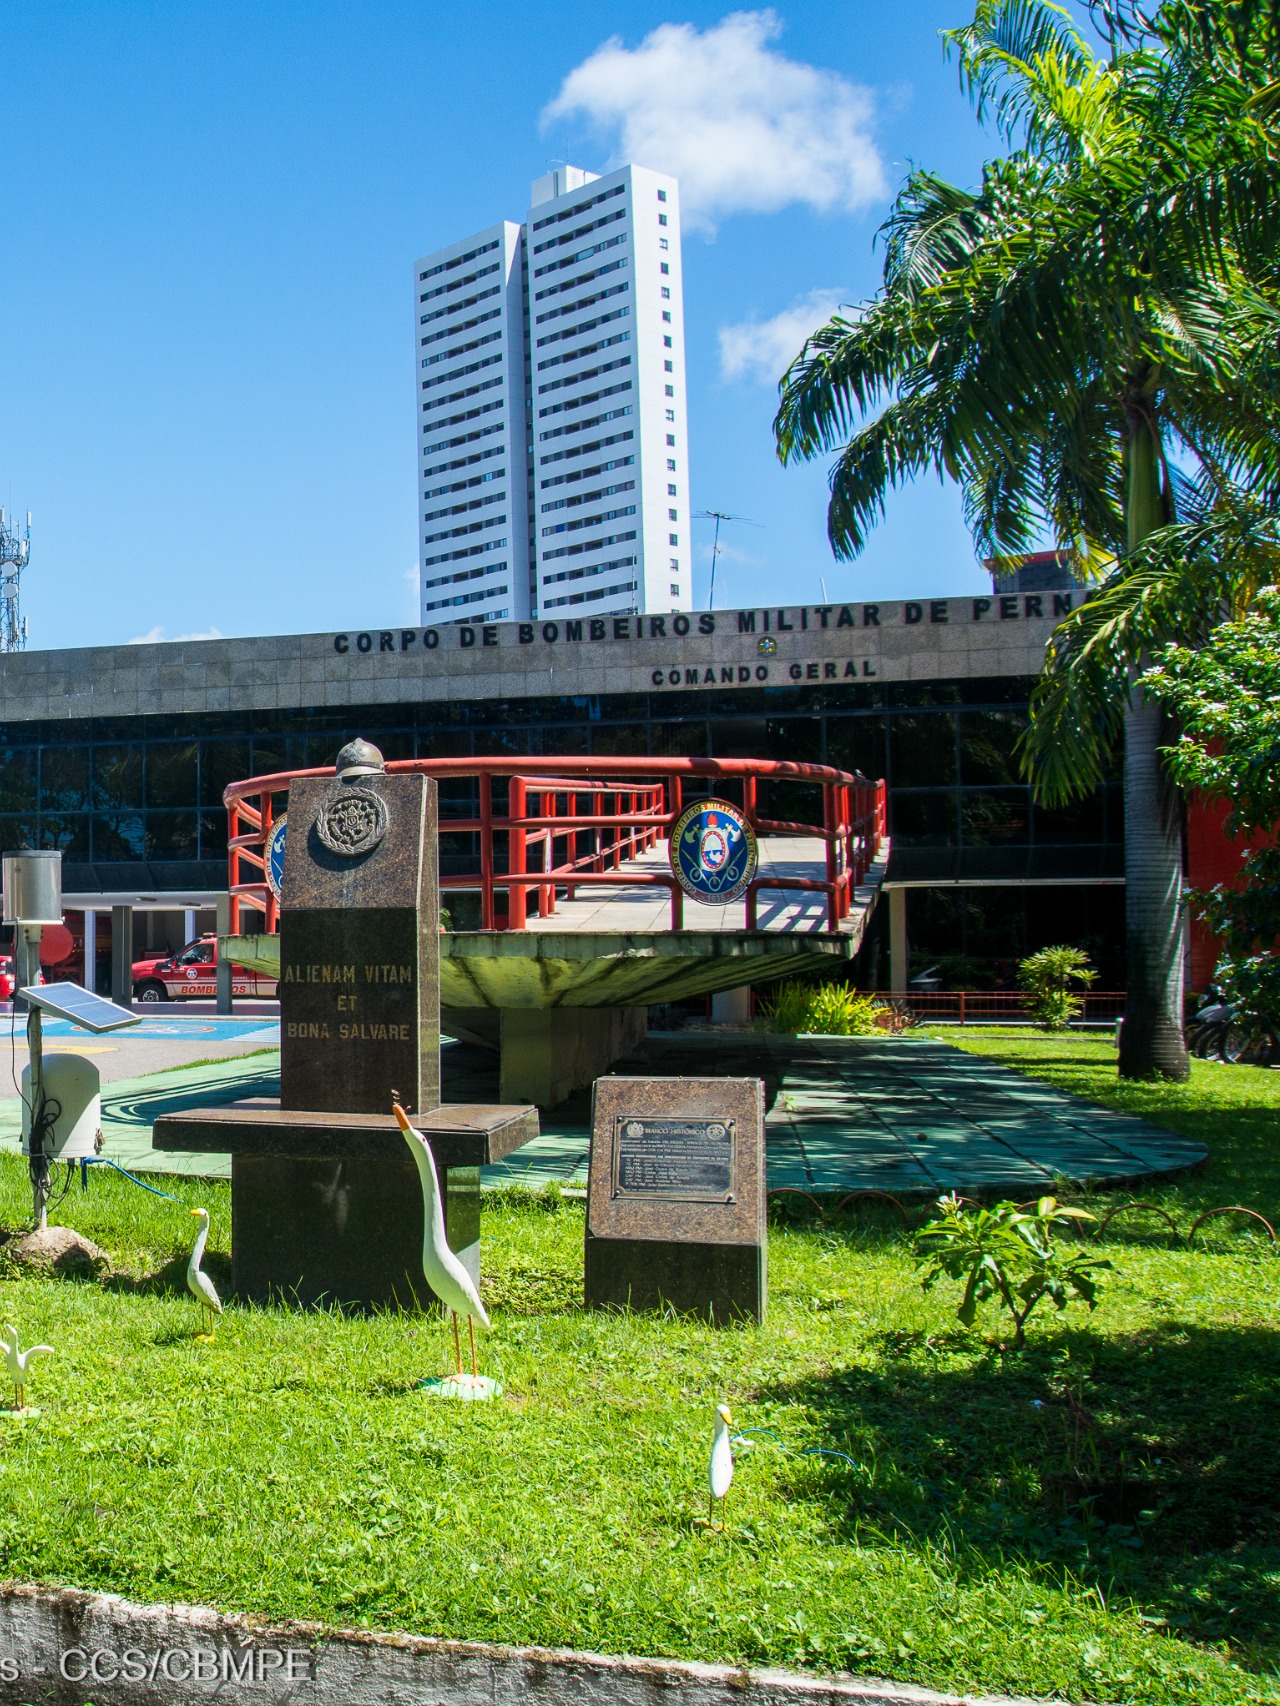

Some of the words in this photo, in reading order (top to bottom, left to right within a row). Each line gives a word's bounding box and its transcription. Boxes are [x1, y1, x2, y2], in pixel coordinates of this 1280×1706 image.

[334, 628, 439, 654] CORPO
[460, 625, 498, 648] DE
[519, 613, 716, 643] BOMBEIROS
[738, 604, 881, 633] MILITAR
[905, 600, 949, 624] DE
[651, 665, 769, 686] COMANDO
[789, 660, 877, 680] GERAL
[673, 803, 705, 848] BOMBEIROS
[707, 803, 740, 820] MILITAR
[284, 964, 356, 983] ALIENAM
[364, 965, 412, 984] VITAM
[181, 985, 246, 994] BOMBEOS
[337, 995, 358, 1012] ET
[287, 1022, 330, 1039] BONA
[339, 1023, 410, 1040] SALVARE
